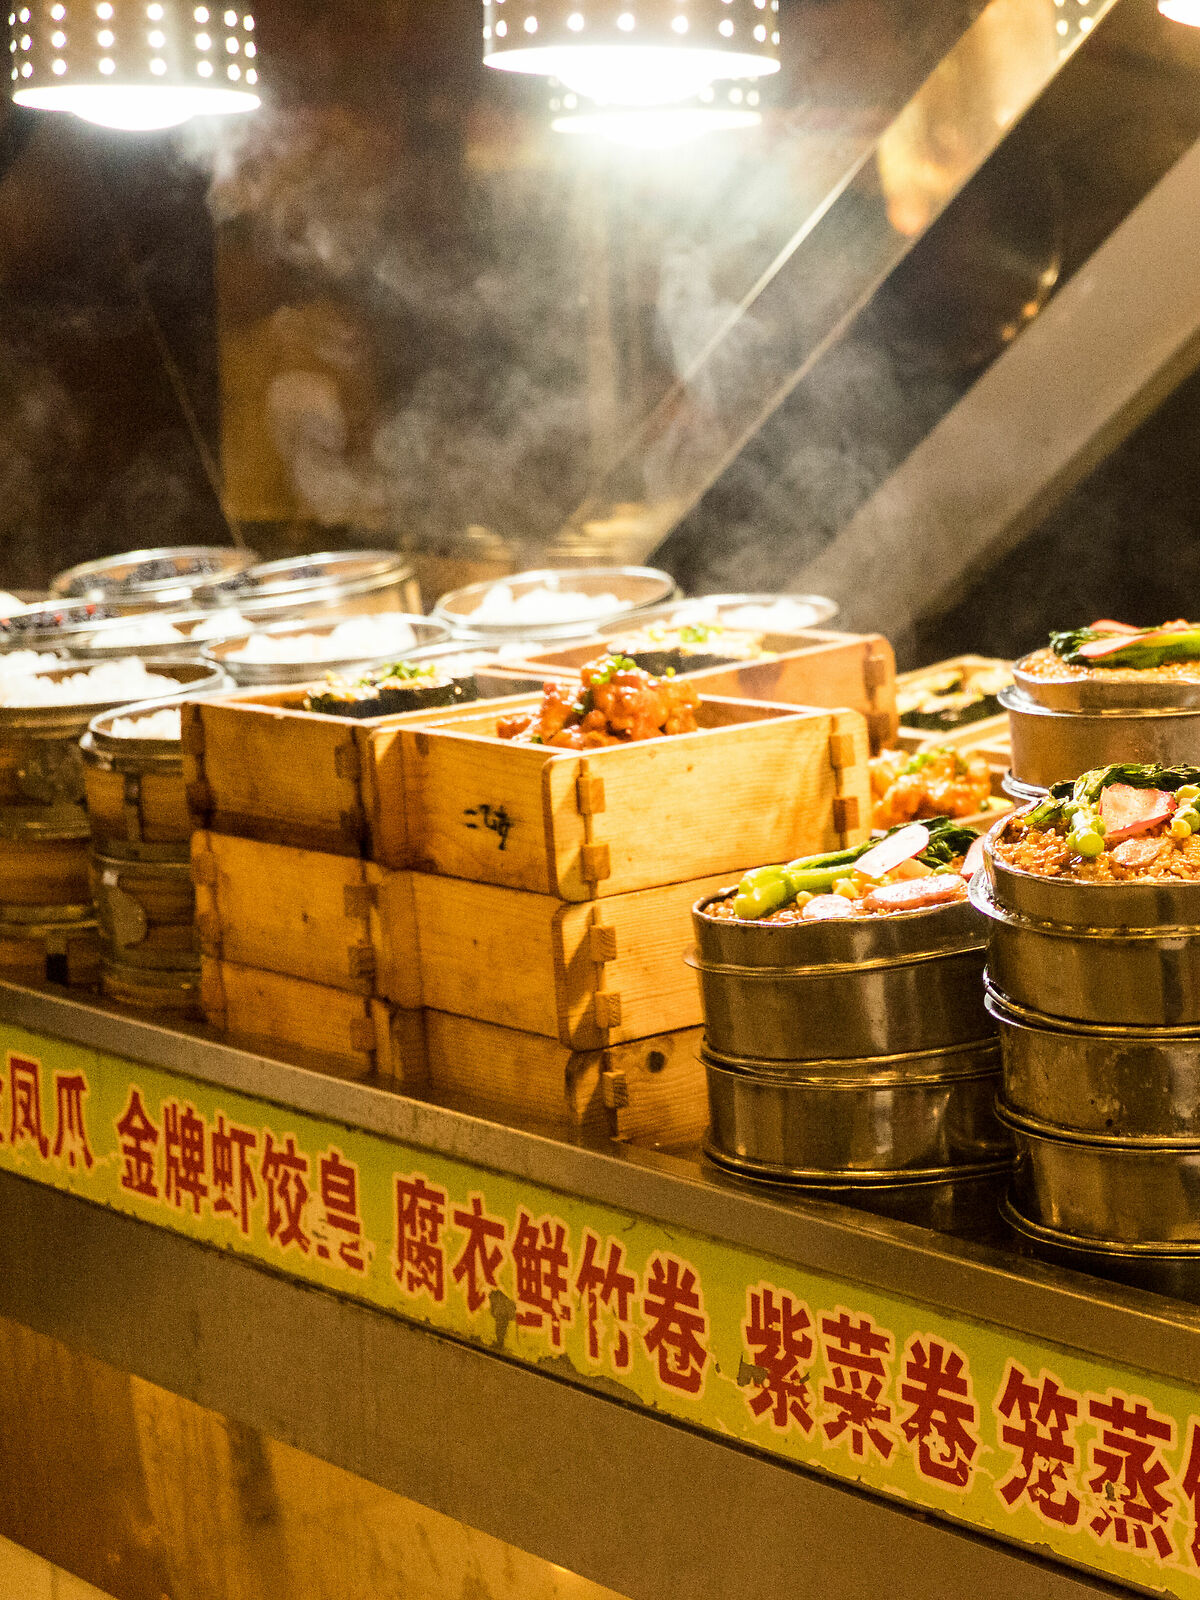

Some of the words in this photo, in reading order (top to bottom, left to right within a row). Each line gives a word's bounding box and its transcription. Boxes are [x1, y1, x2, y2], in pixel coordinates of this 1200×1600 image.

[0, 1057, 93, 1169] 凤爪
[116, 1091, 365, 1272] 金牌虾饺皇
[396, 1179, 707, 1394] 腐衣鲜竹卷
